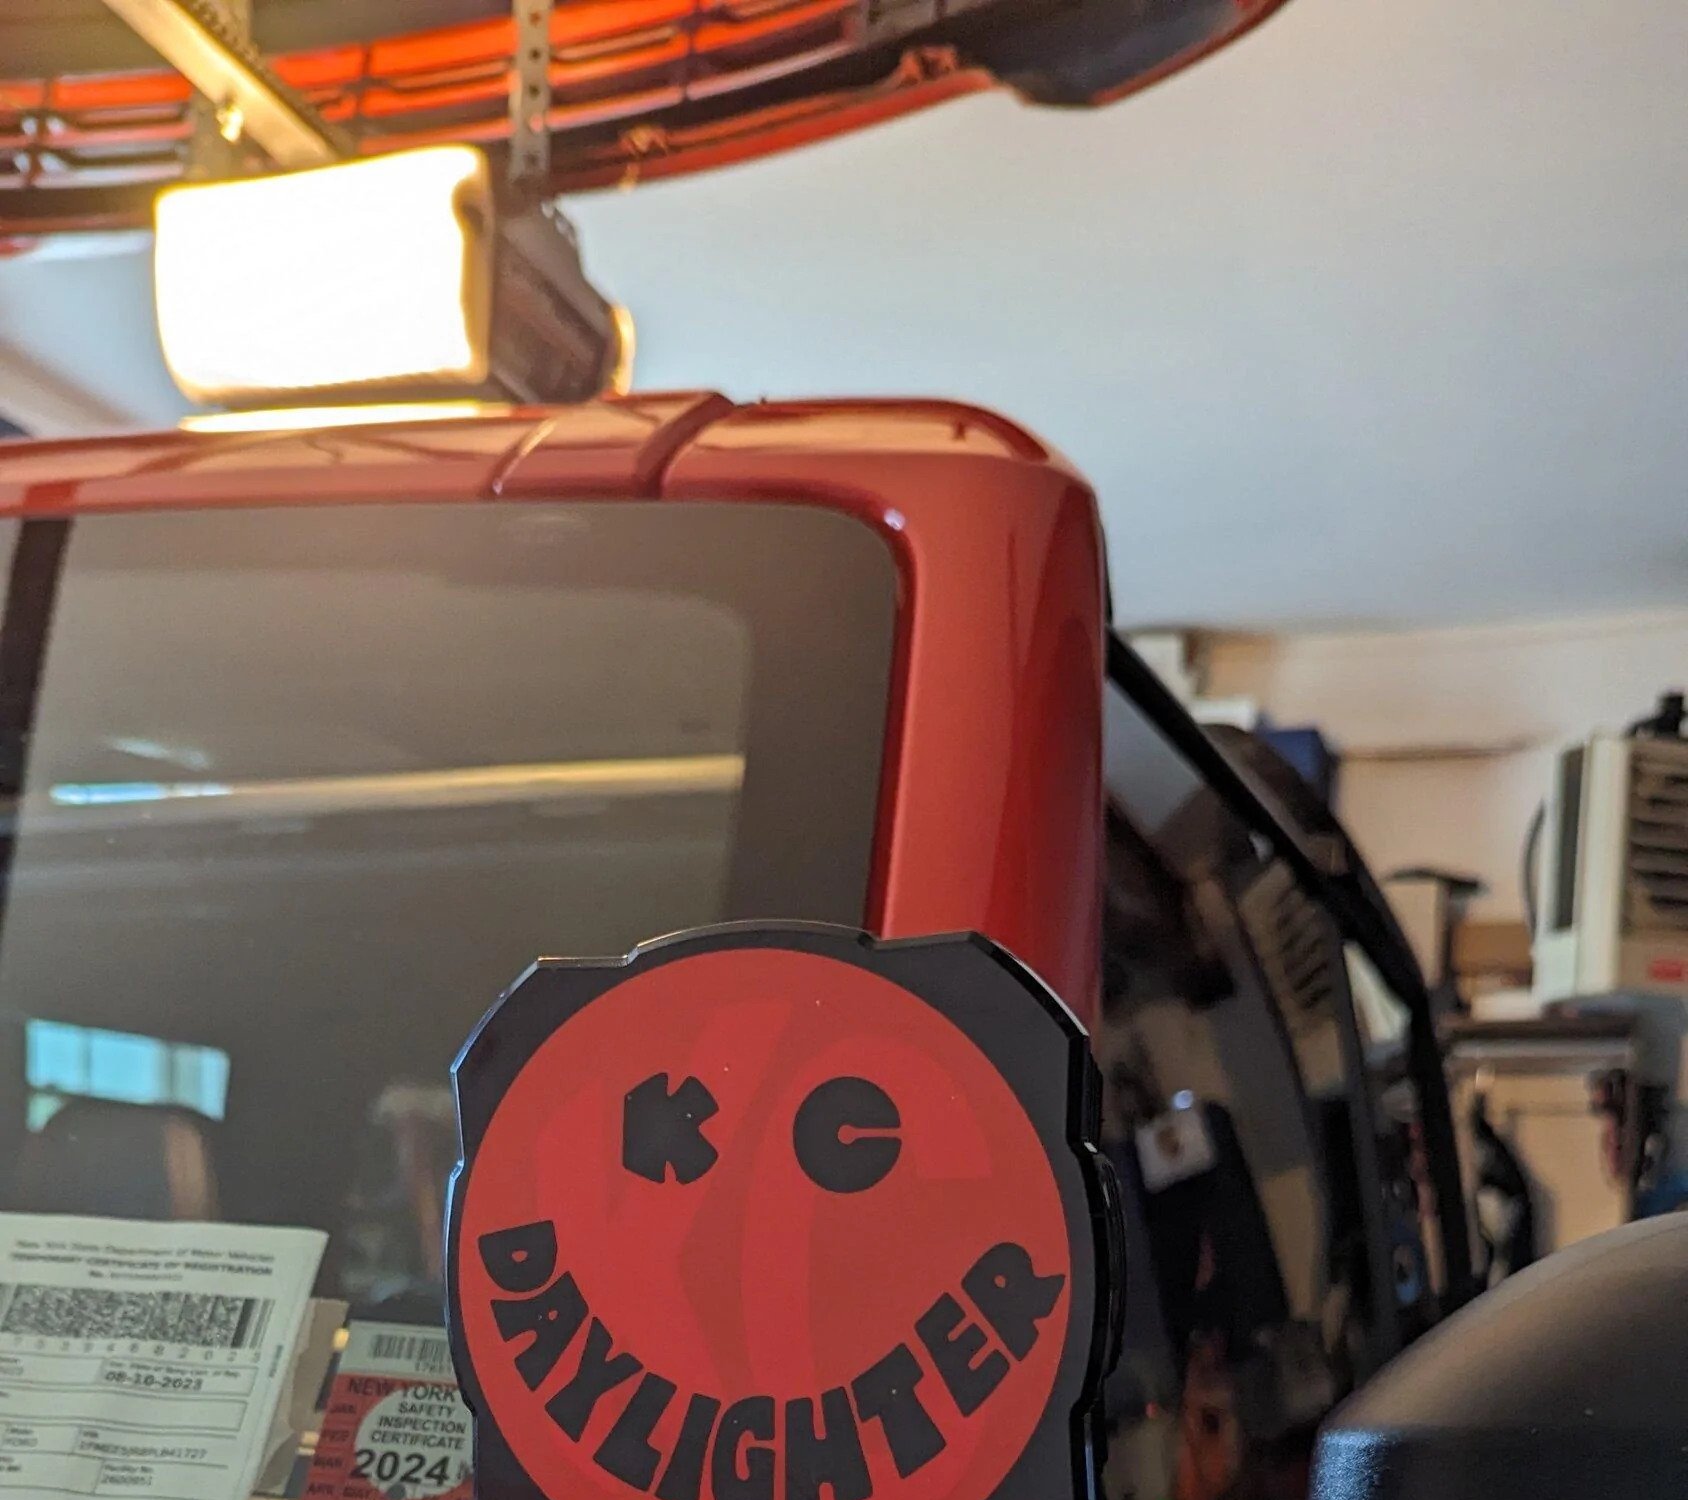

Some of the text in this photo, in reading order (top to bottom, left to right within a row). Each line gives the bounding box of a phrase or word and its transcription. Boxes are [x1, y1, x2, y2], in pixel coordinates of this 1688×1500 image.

[104, 1371, 203, 1391] 08-10-2023
[349, 1378, 456, 1402] NEW YORK
[398, 1401, 455, 1418] SAFETY
[378, 1415, 467, 1435] INSPECTION
[370, 1430, 464, 1450] CERTIFICATE
[350, 1448, 450, 1487] 2024
